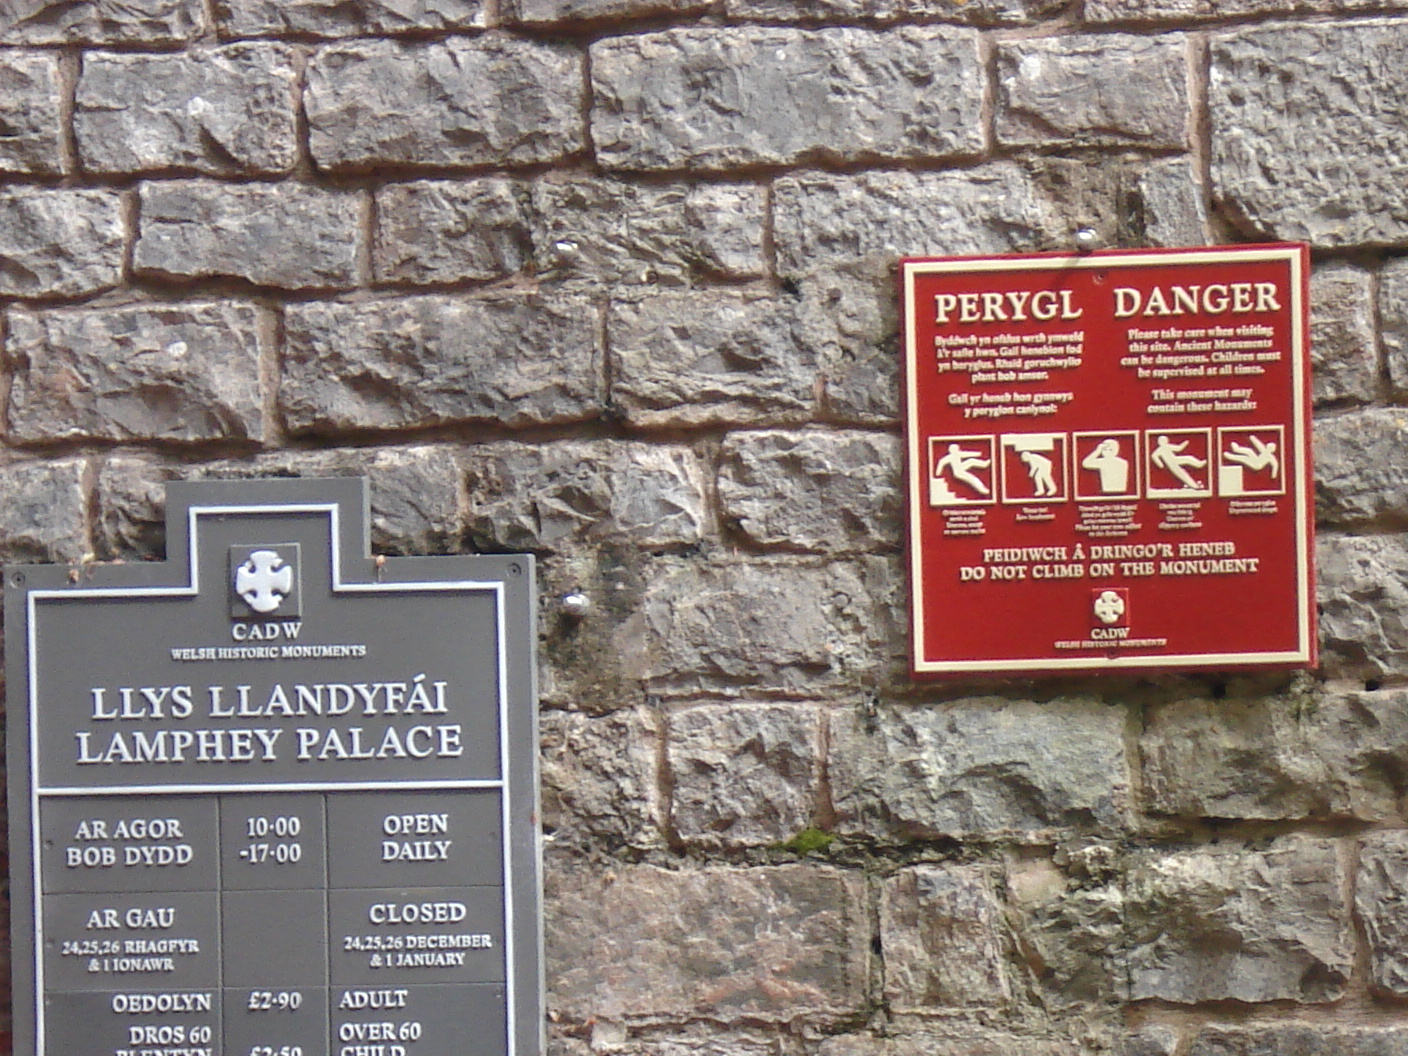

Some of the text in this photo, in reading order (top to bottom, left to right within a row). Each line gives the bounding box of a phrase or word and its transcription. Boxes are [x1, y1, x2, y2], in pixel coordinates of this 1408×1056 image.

[935, 290, 1083, 323] PERYGL
[1113, 282, 1281, 317] DANGER
[1128, 324, 1274, 339] Please take care when visiting
[1129, 342, 1148, 352] this
[1174, 341, 1212, 351] Ancient
[1214, 339, 1273, 349] Monuments
[1121, 356, 1139, 365] can
[1211, 352, 1254, 362] Children
[1257, 351, 1281, 360] must
[1152, 388, 1252, 400] This monument may
[1147, 403, 1184, 413] contain
[1187, 402, 1213, 412] these
[983, 547, 1067, 562] PEIDIWCH
[1090, 543, 1174, 559] DRINGO'R
[1179, 542, 1235, 557] HENEB
[960, 558, 1259, 581] DO NOT CLIMB ON THE MONUMENT
[233, 622, 302, 640] CADW
[1091, 627, 1130, 639] CADW
[171, 645, 367, 660] WELSH HISTORIC MONUMENTS
[91, 673, 448, 719] LLYS LLANDYFÁI
[75, 725, 463, 763] LAMPHEY PALACE
[75, 819, 183, 840] AR AGOR
[383, 814, 448, 834] OPEN
[67, 845, 193, 867] BOB DYDD
[382, 841, 451, 861] DAILY
[87, 908, 174, 929] AR GAU
[370, 903, 467, 923] CLOSED
[124, 940, 199, 954] RHAGFYR
[406, 935, 492, 948] DECEMBER
[113, 958, 174, 971] IONAWR
[396, 953, 465, 966] JANUARY
[112, 993, 212, 1013] OEDOLYN
[340, 990, 407, 1008] ADULT
[130, 1026, 211, 1045] DROS 60
[340, 1022, 421, 1041] OVER 60
